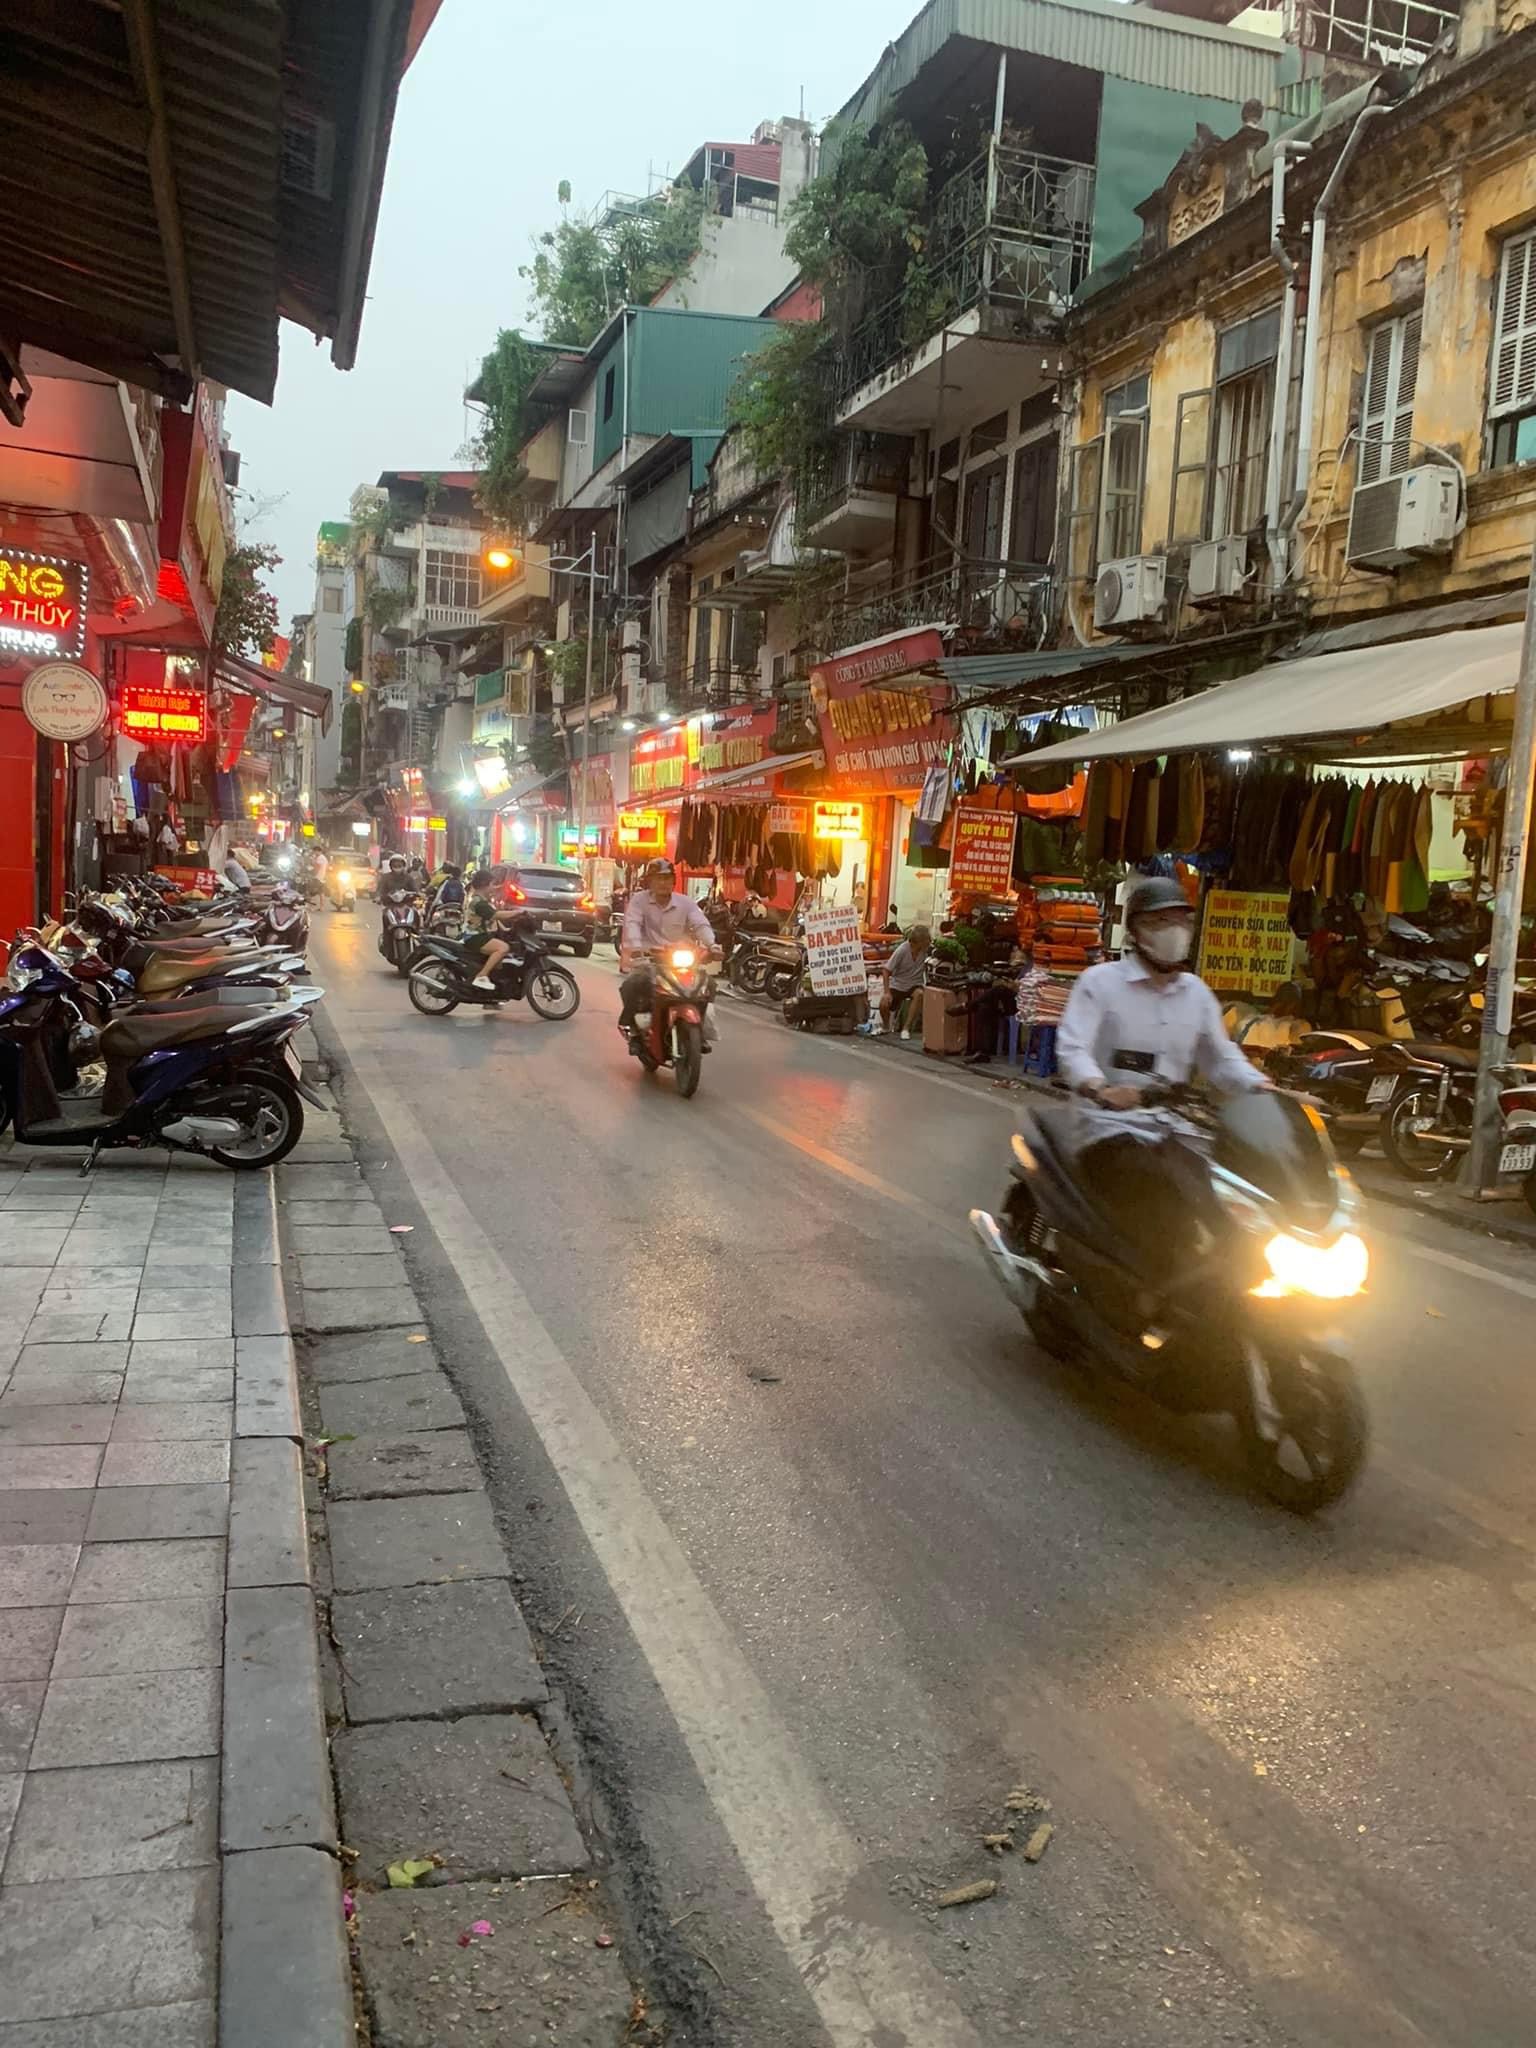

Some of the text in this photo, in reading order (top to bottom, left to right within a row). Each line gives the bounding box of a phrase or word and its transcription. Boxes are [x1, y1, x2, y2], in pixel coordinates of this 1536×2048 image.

[10, 599, 72, 628] THÚY
[1209, 914, 1244, 929] CHUYÊN
[1266, 936, 1290, 952] VALY
[1268, 953, 1288, 975] GHẾ
